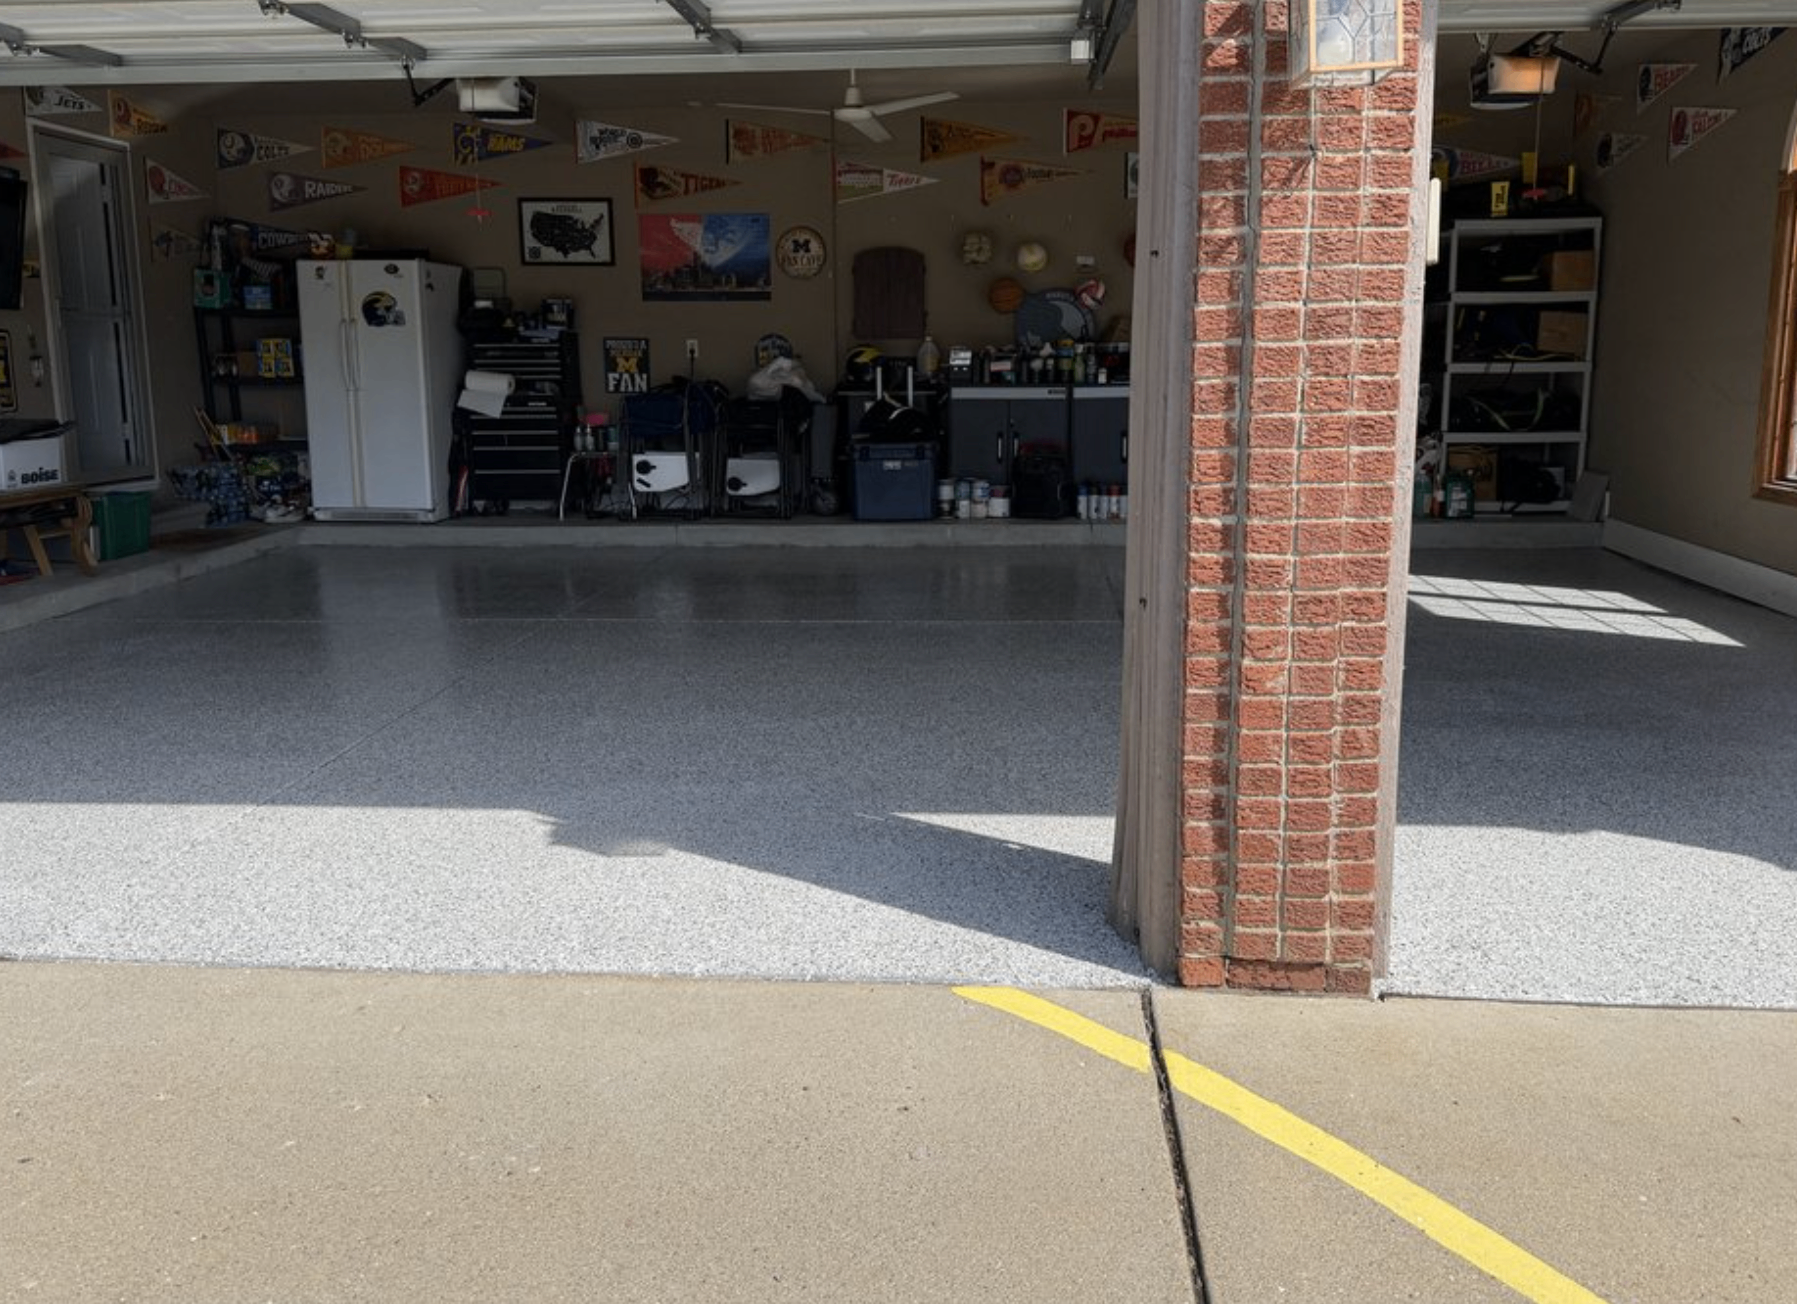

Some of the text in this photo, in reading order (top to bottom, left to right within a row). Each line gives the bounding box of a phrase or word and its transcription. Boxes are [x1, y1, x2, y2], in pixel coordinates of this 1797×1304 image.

[257, 230, 306, 250] COWB
[792, 238, 811, 254] M
[616, 356, 639, 374] M
[607, 372, 648, 393] FAN
